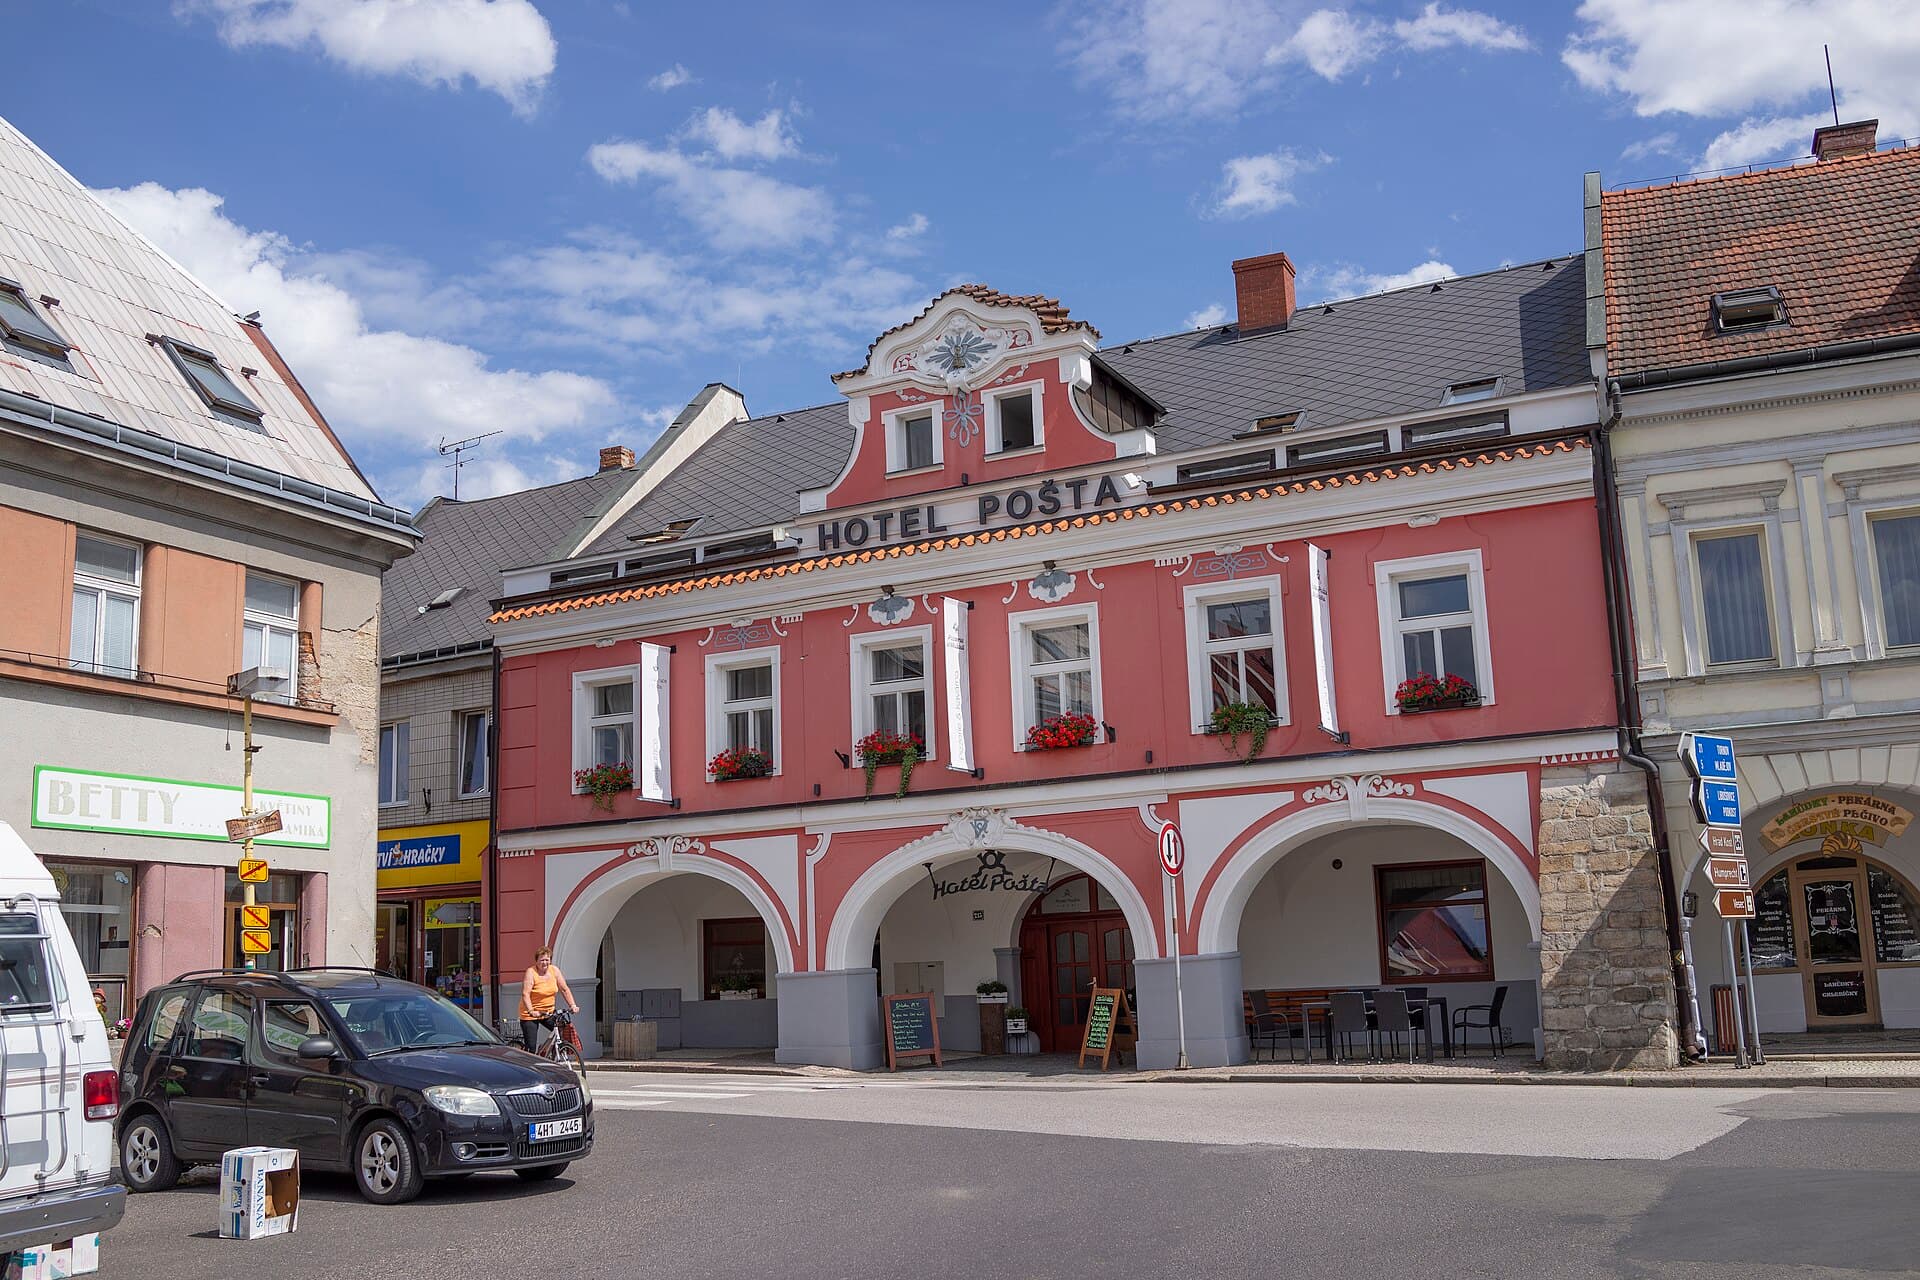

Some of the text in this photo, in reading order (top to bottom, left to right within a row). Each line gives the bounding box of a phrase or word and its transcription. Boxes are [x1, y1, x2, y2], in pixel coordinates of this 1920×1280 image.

[818, 475, 1121, 551] HOTEL POŠTA
[48, 779, 182, 824] BETTY
[1838, 796, 1897, 815] PEKÁRNA
[1843, 809, 1889, 826] PEČIVO
[403, 844, 446, 865] HRAČKY
[933, 873, 1050, 900] Hotel Pošta
[538, 1120, 578, 1136] 4H1 2445
[256, 1169, 264, 1228] BANANAS
